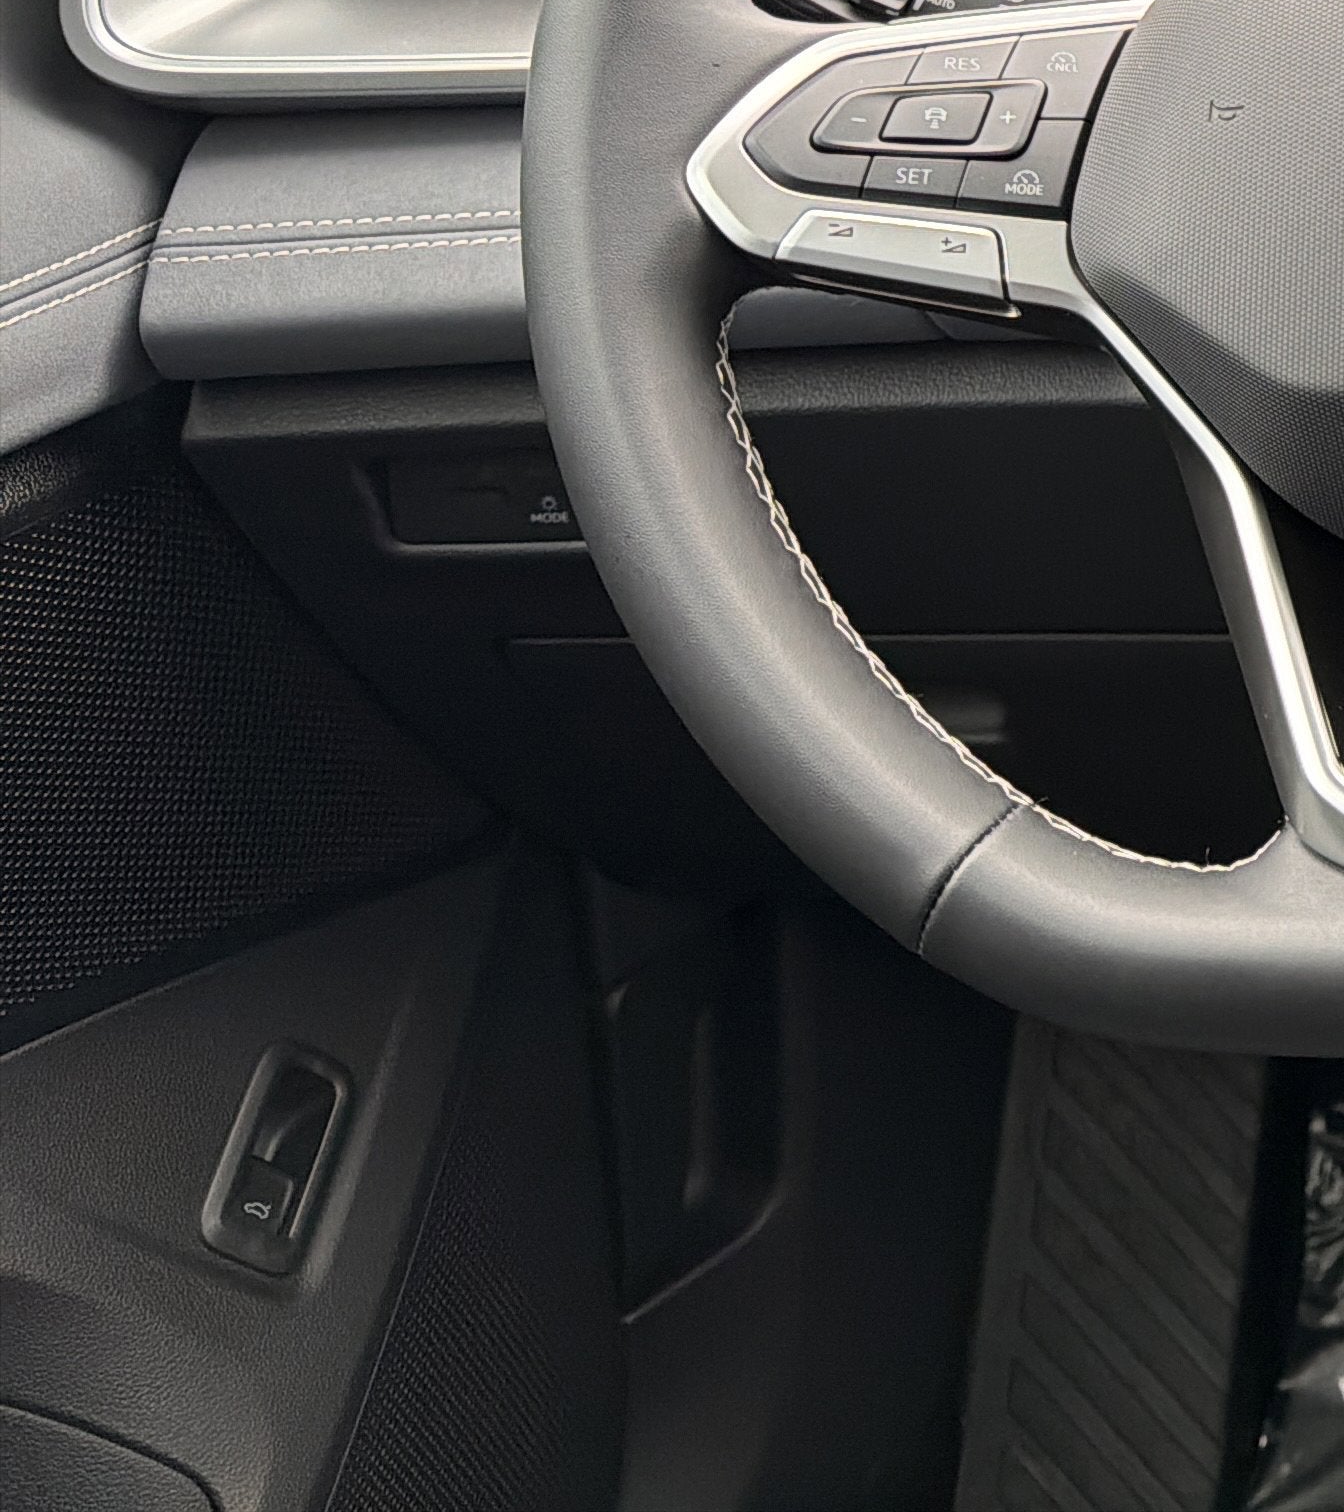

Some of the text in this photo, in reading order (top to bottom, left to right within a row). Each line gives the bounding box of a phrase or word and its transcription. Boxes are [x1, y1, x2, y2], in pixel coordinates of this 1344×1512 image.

[943, 56, 982, 72] RES
[1046, 62, 1079, 73] CNCL
[895, 168, 934, 186] SET
[1004, 182, 1045, 196] MODE
